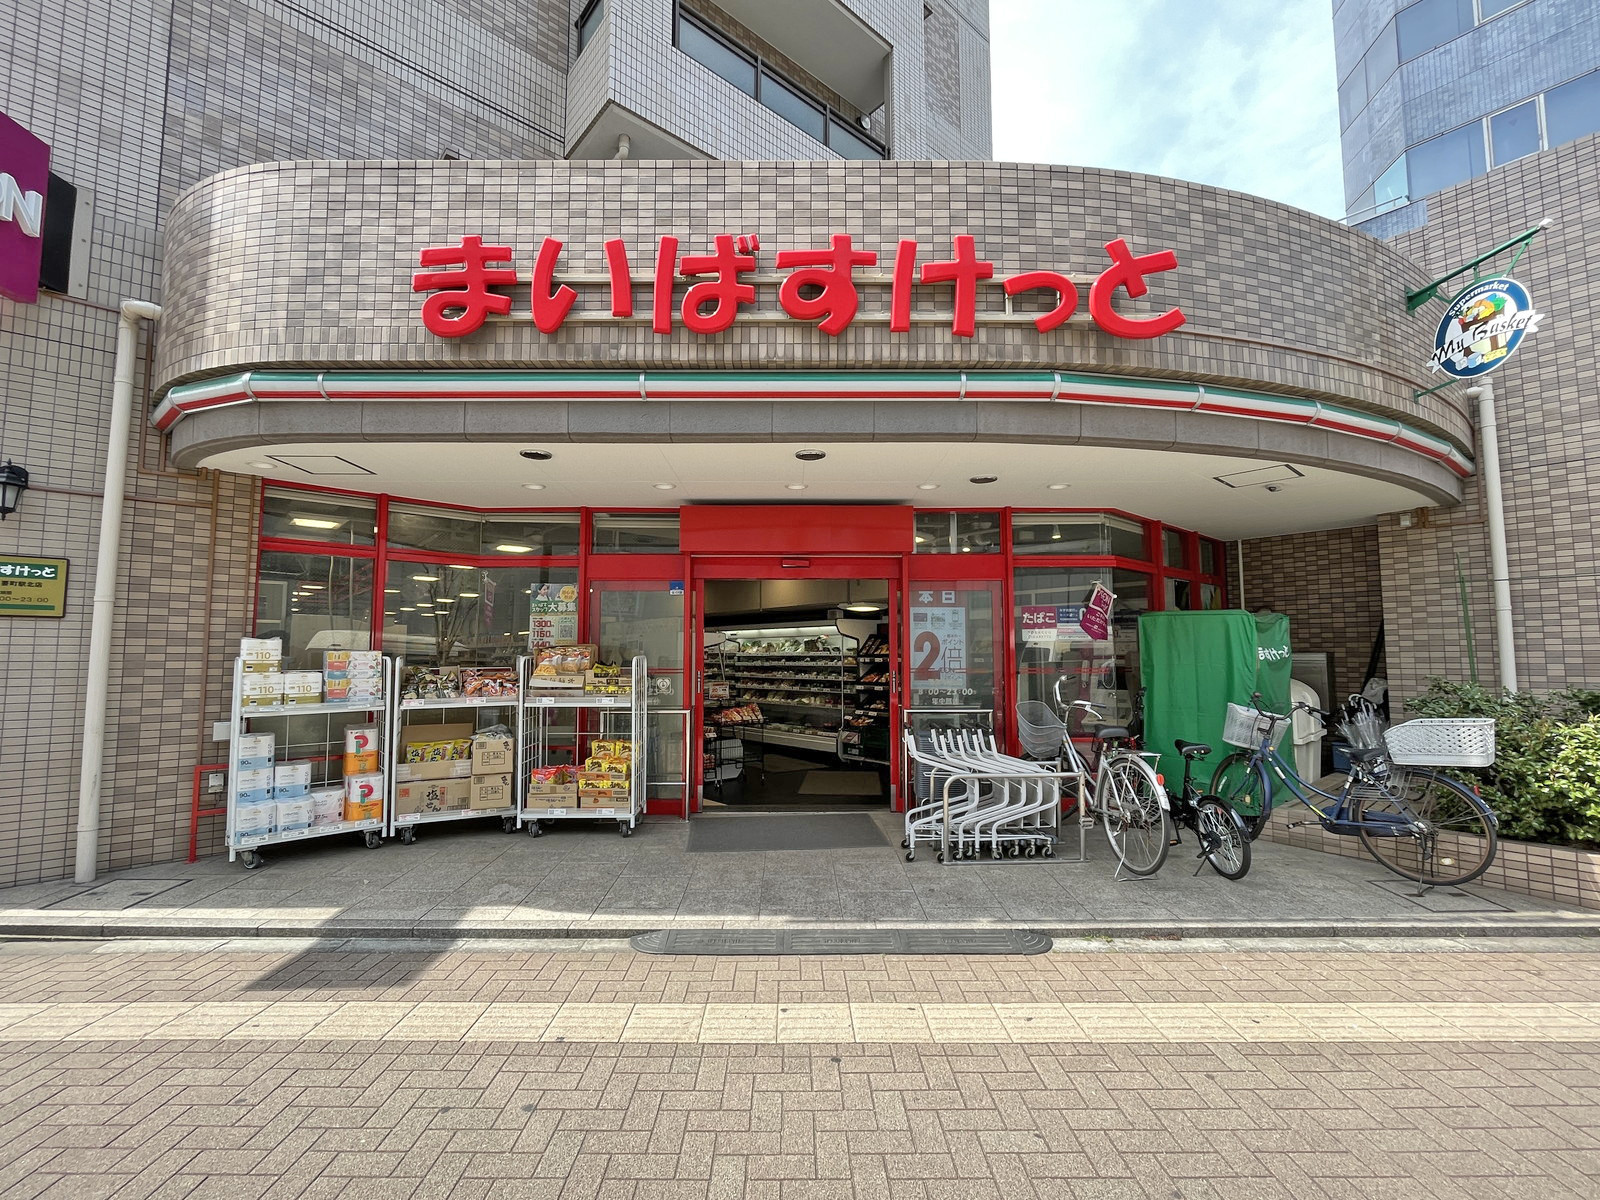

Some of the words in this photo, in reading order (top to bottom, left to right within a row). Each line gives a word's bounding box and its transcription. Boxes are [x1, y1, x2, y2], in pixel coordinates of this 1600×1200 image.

[0, 172, 43, 238] N
[412, 233, 1187, 340] まいばすけっと
[1448, 281, 1510, 319] Supermarket
[1432, 337, 1465, 364] My
[1473, 314, 1533, 342] Basket
[548, 602, 577, 612] 大募集
[918, 590, 956, 604] 本日
[1022, 612, 1056, 624] たばこ
[913, 631, 941, 681] 2
[941, 646, 963, 672] 倍
